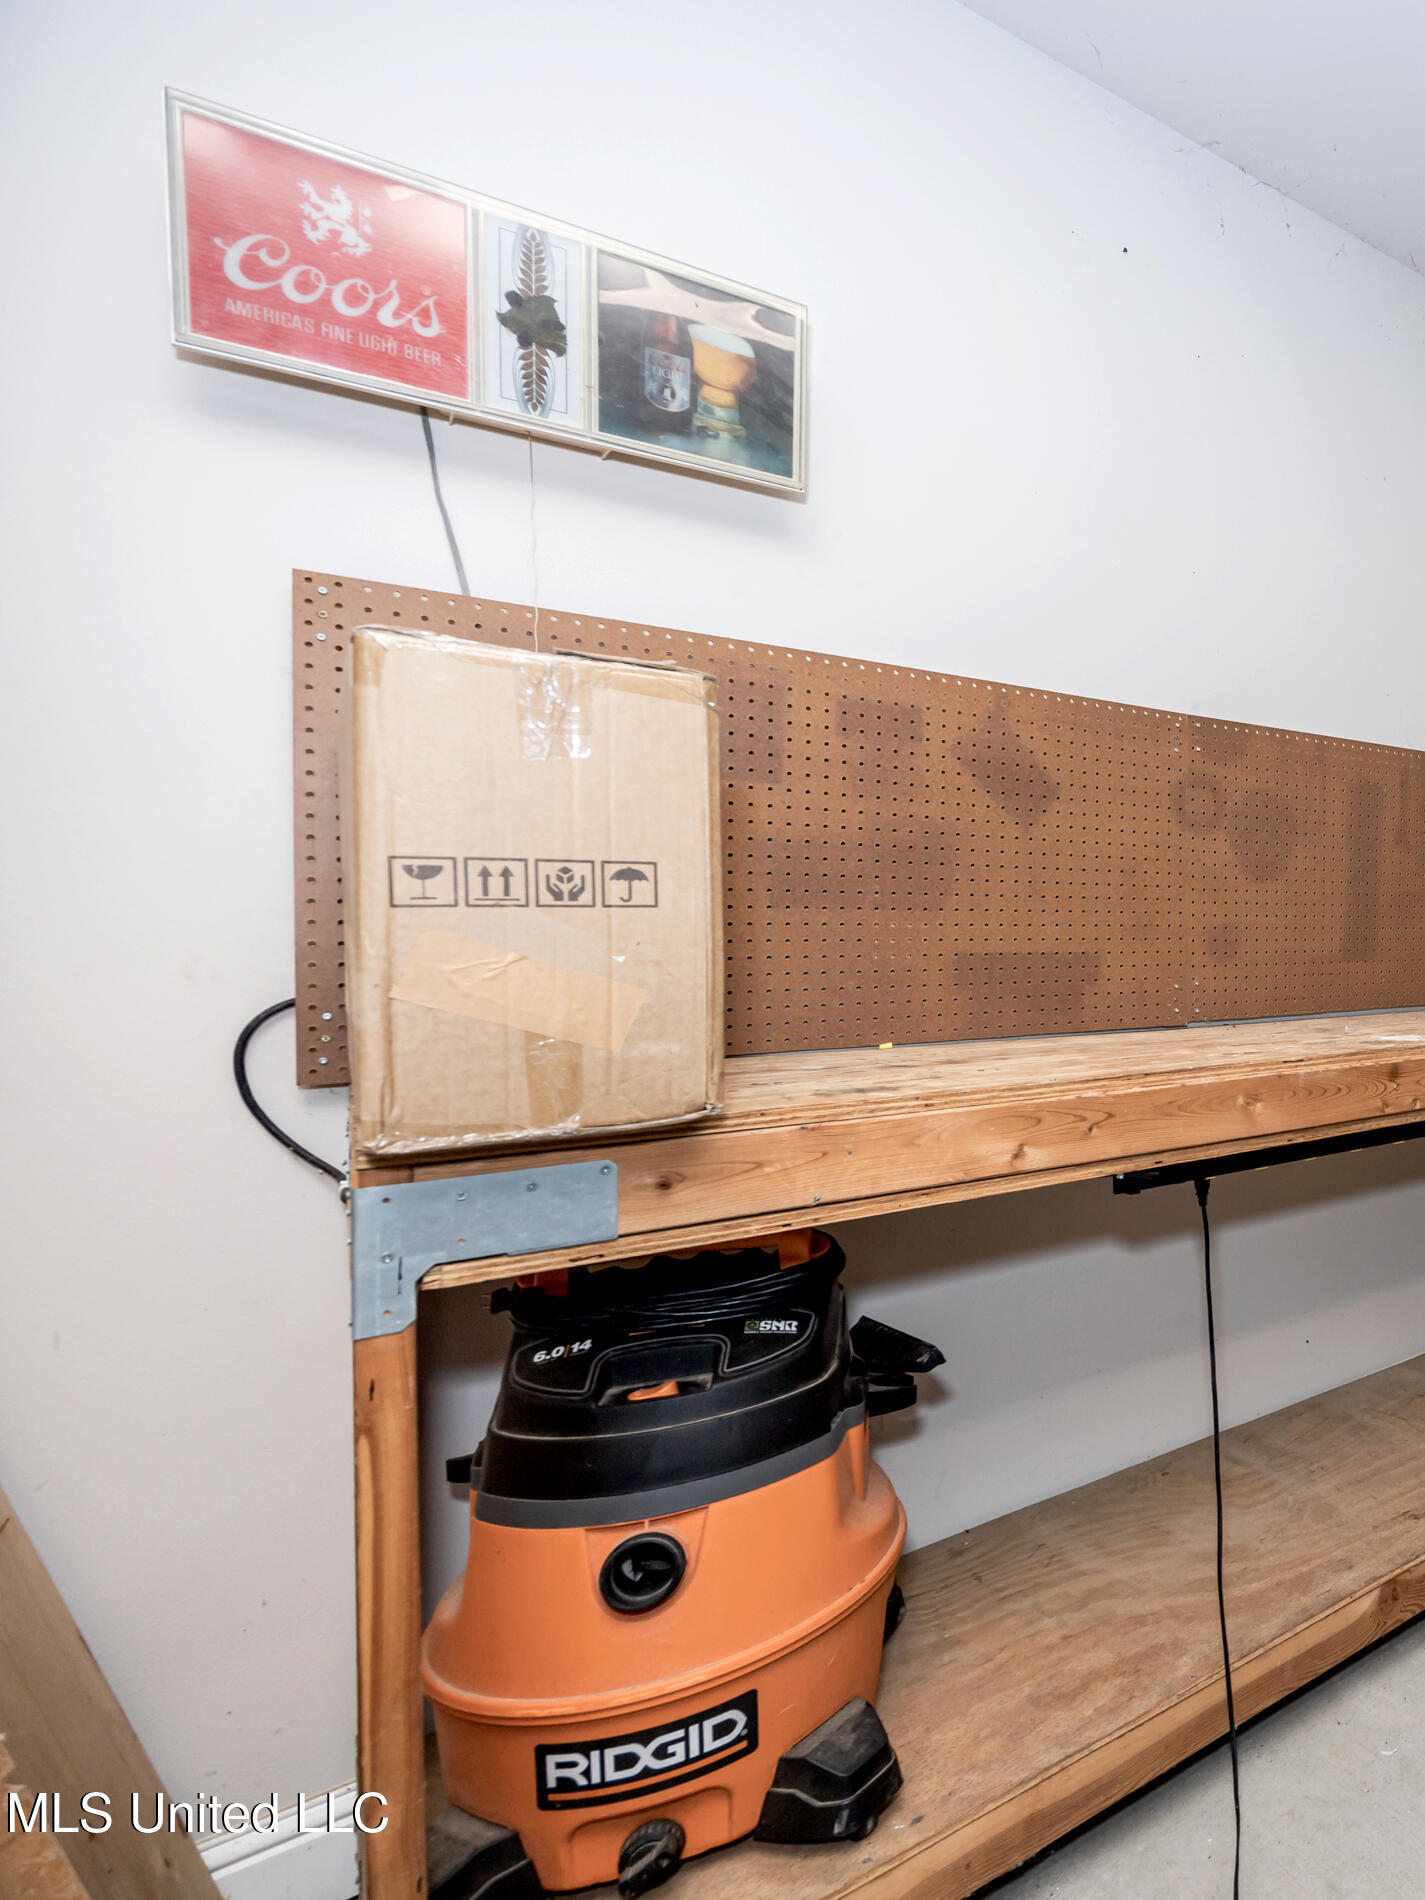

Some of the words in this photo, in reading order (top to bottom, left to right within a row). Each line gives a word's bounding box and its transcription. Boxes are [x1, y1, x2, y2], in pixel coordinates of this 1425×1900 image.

[213, 234, 446, 338] Coors
[321, 322, 354, 345] FINE
[358, 331, 398, 357] LIGHT
[403, 343, 442, 367] BEER
[758, 1320, 799, 1331] SNR
[545, 1709, 747, 1788] RIDGID
